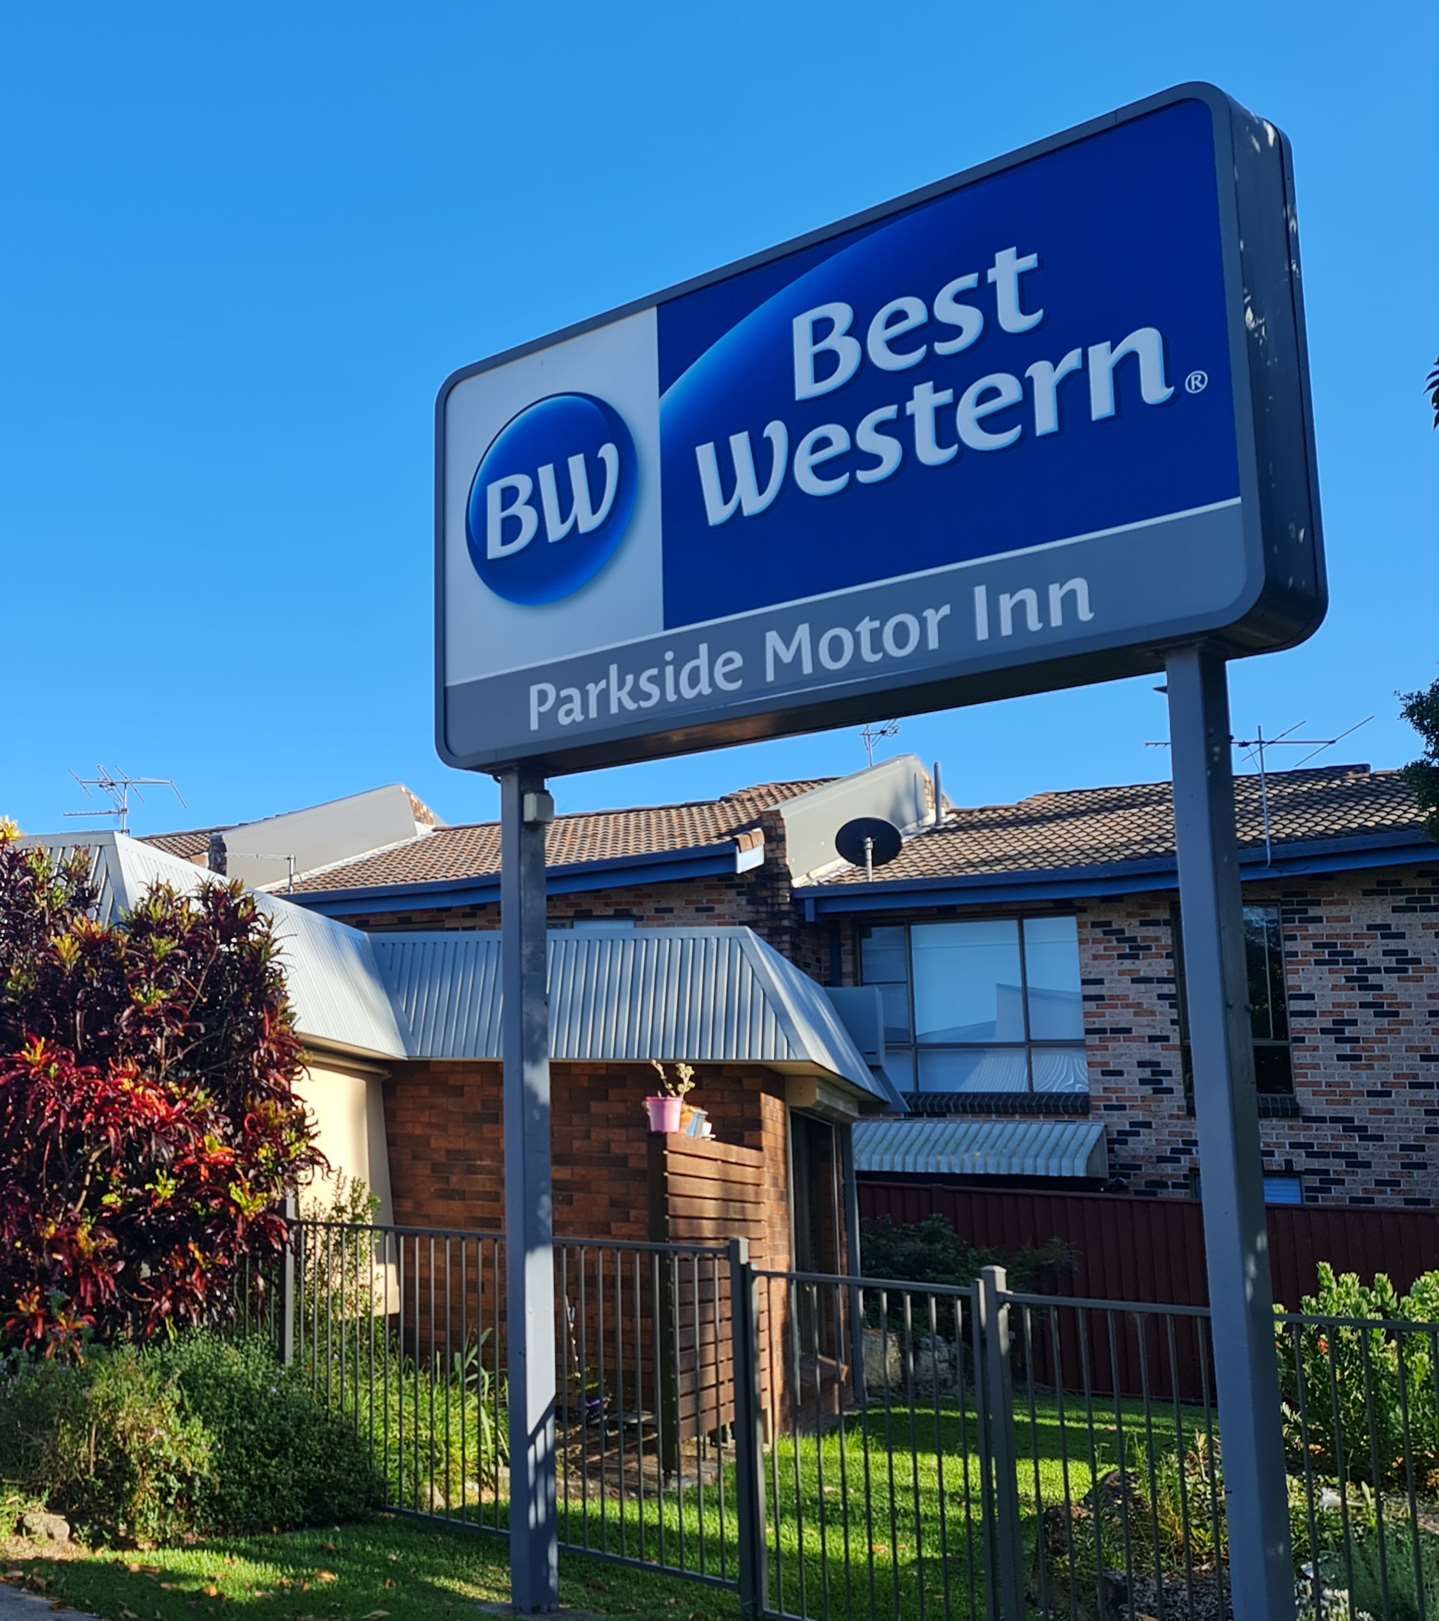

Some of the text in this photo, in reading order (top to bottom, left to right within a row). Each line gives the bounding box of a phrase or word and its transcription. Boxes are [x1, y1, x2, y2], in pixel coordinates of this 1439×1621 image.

[791, 246, 1045, 401] Best
[486, 442, 620, 560] BW
[695, 326, 1175, 527] Western
[528, 576, 1095, 731] Parkside Motor Inn
